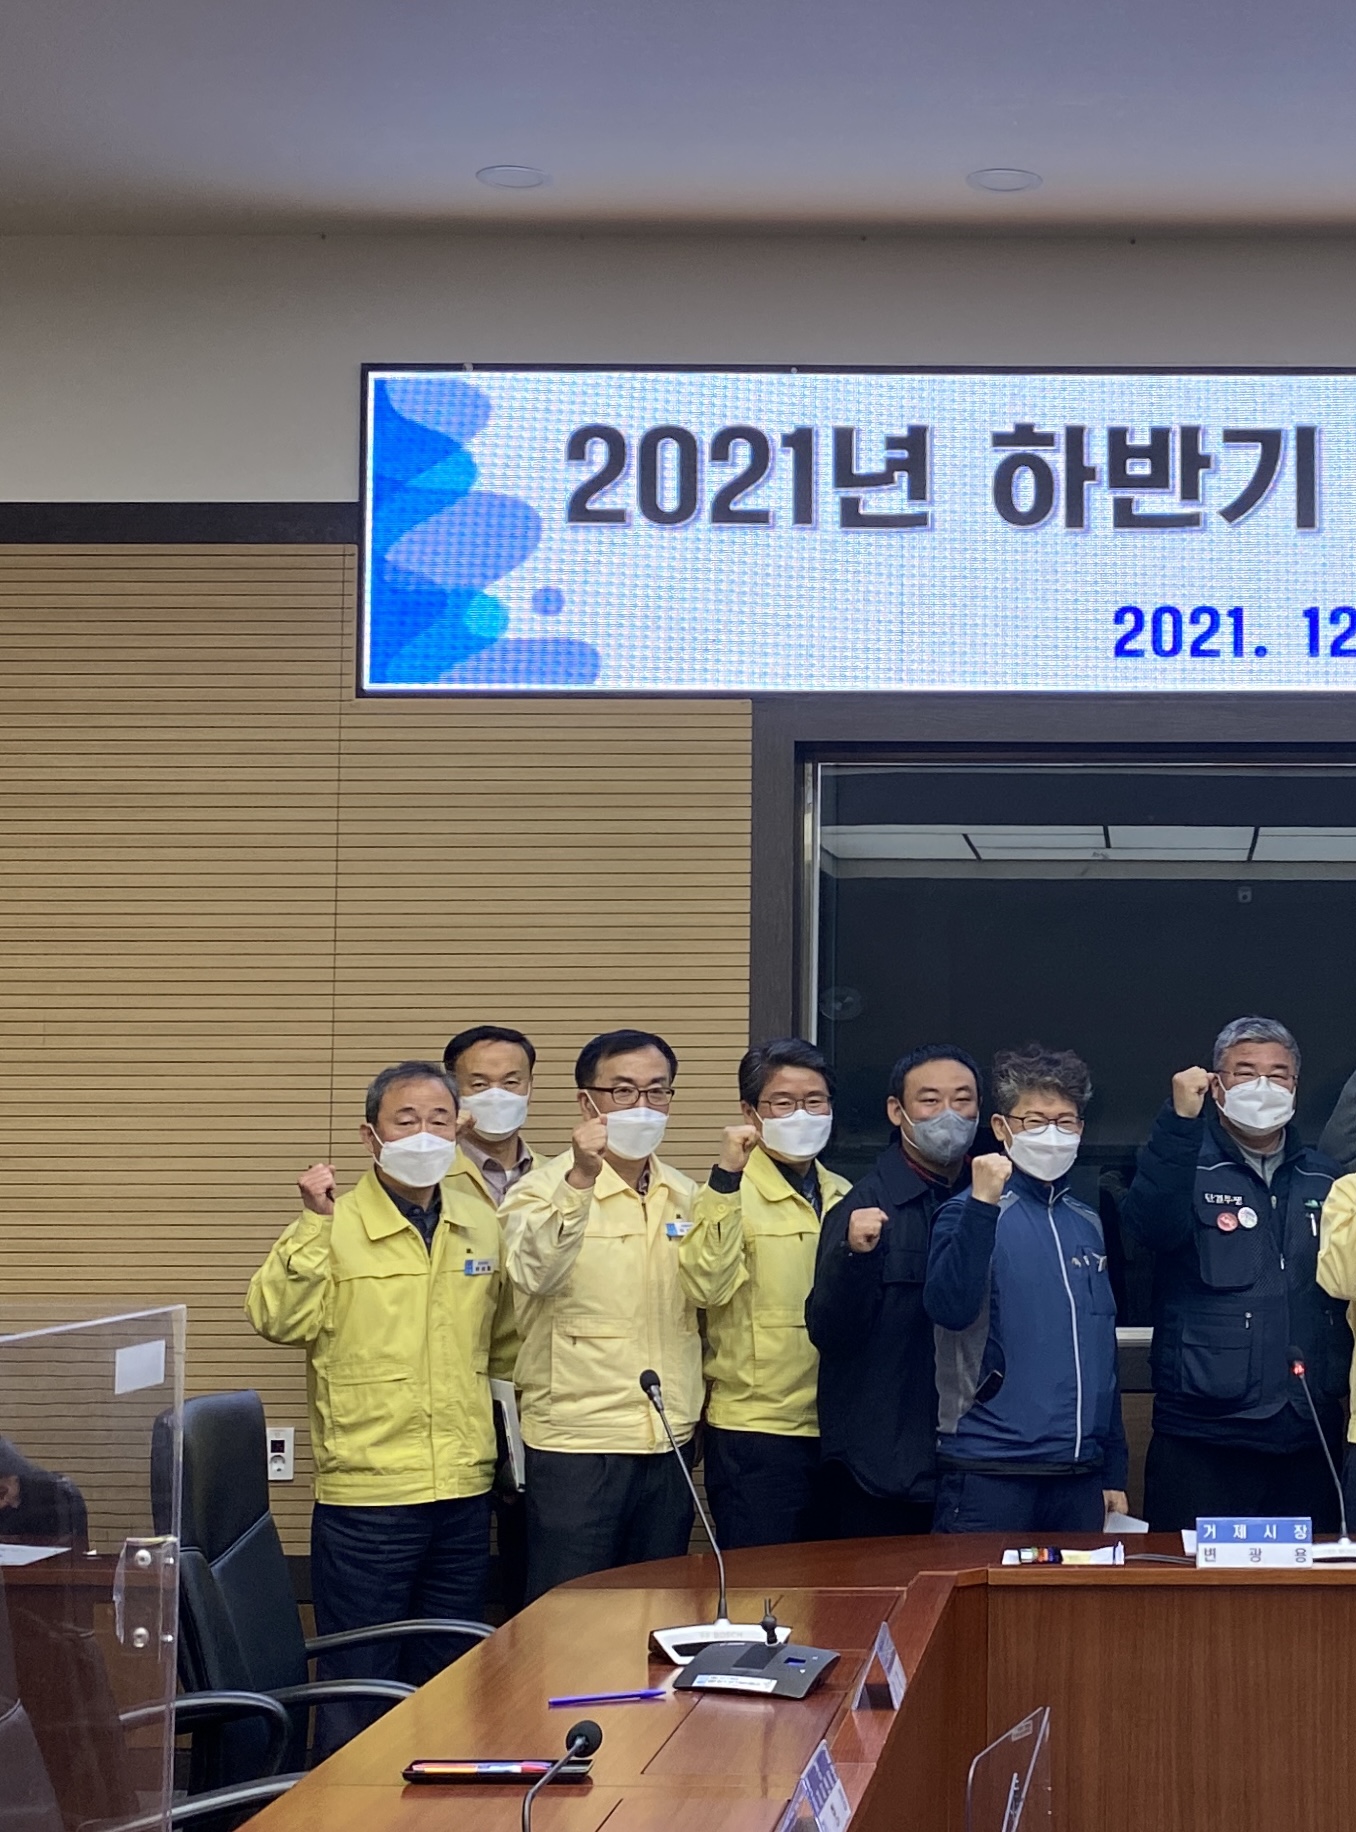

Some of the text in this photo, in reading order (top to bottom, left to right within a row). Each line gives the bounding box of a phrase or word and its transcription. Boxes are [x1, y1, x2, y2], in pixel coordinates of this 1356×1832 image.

[566, 424, 933, 529] 2021년
[989, 422, 1319, 532] 하반기
[1112, 605, 1267, 660] 2021.
